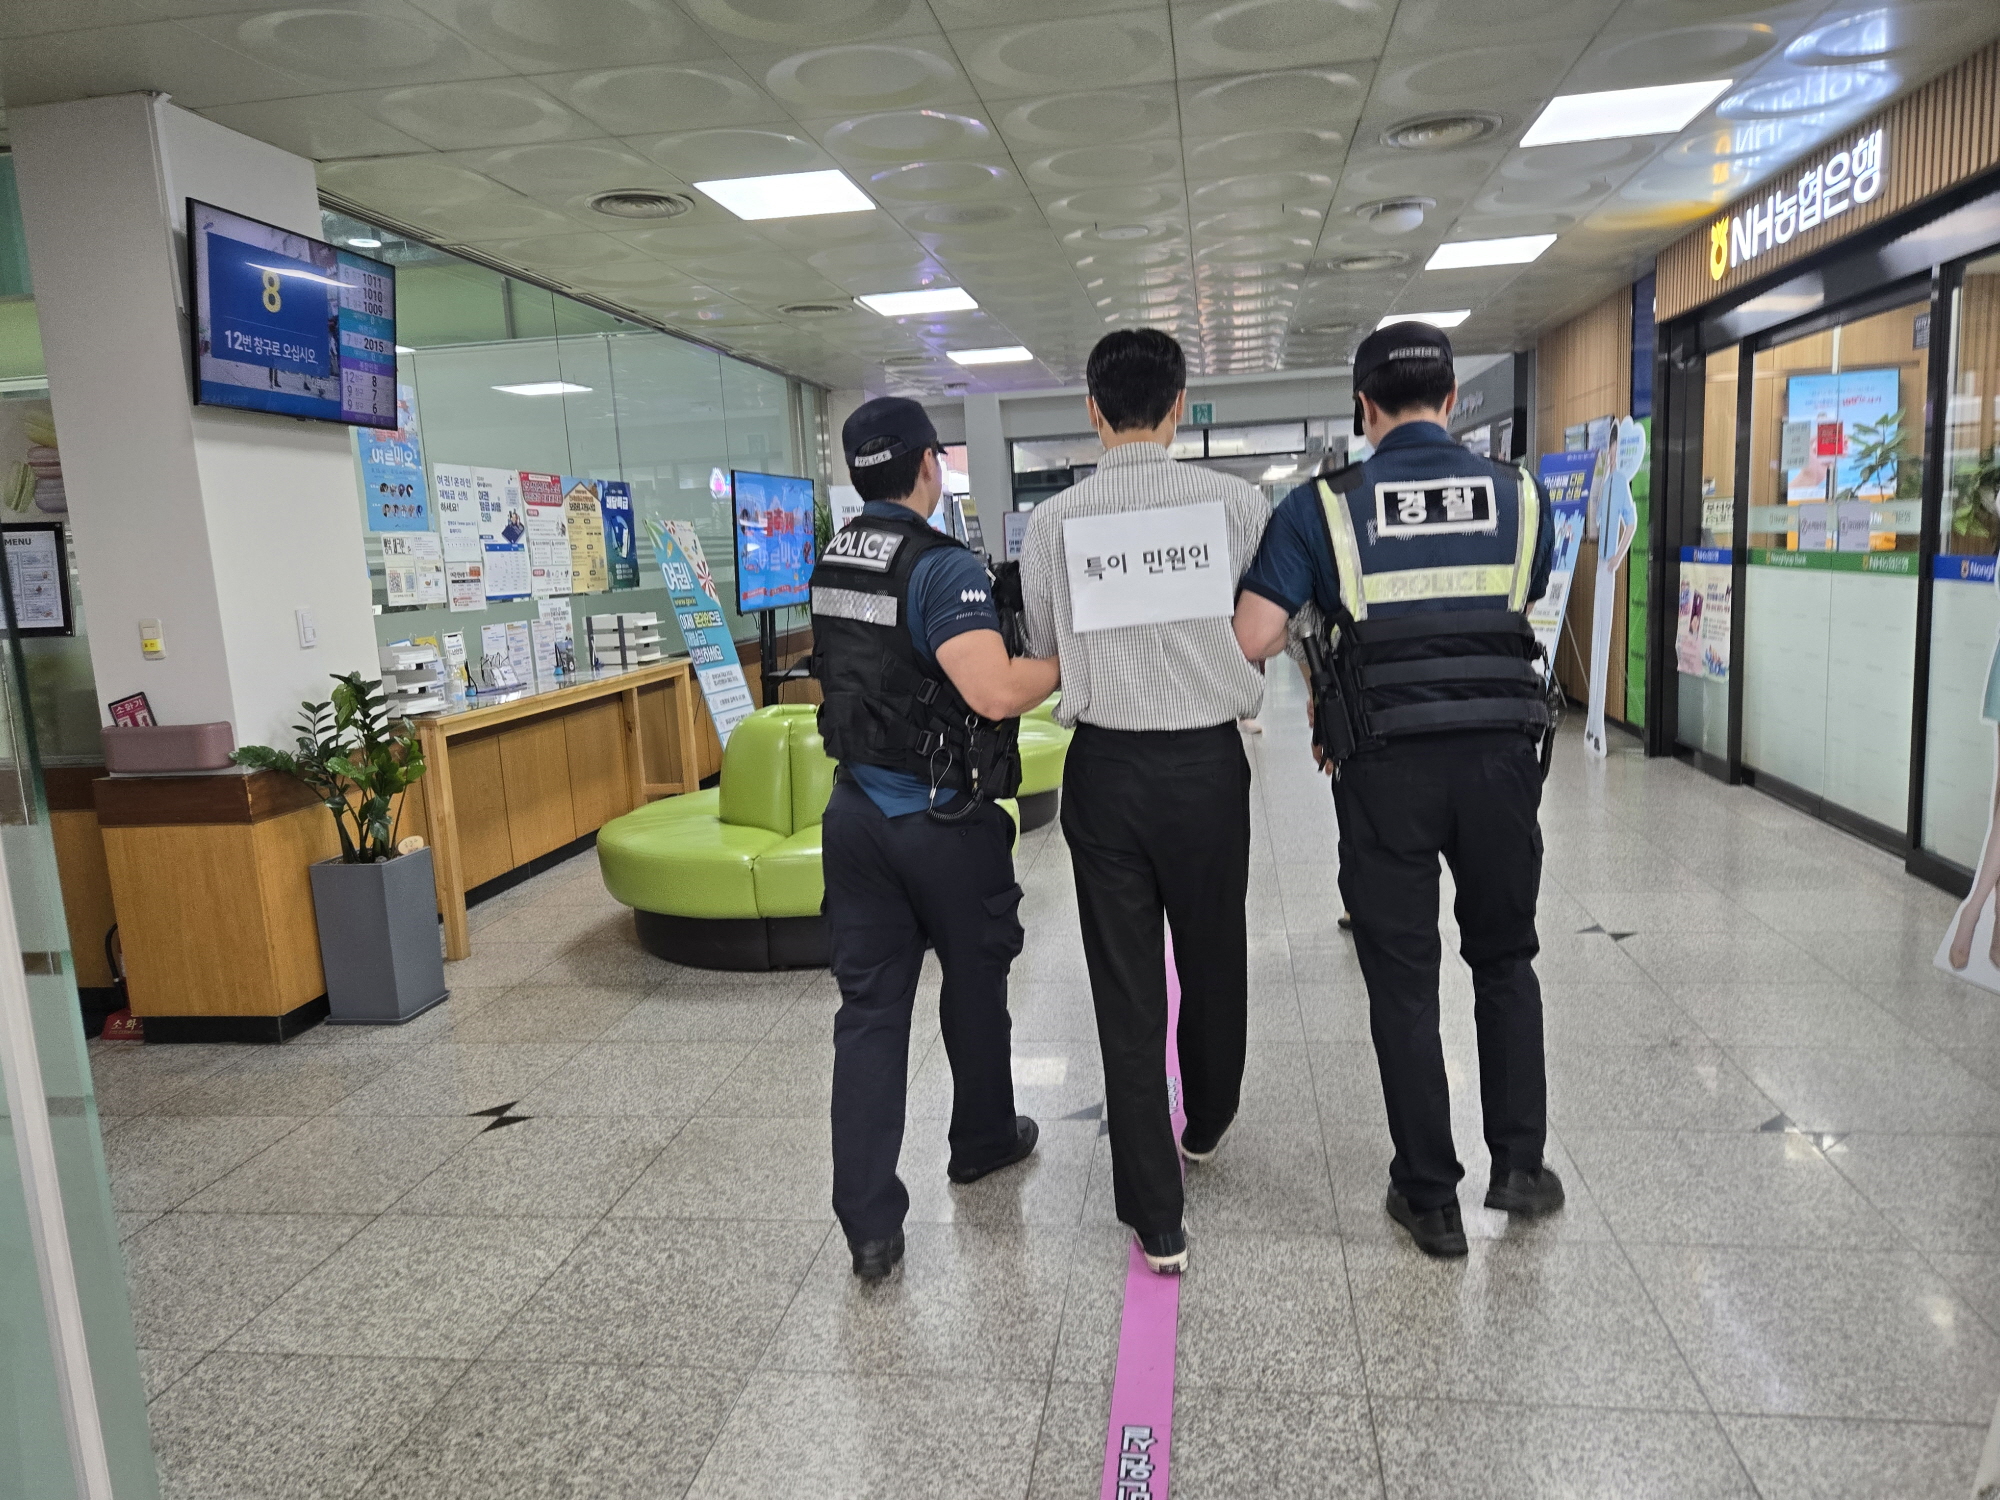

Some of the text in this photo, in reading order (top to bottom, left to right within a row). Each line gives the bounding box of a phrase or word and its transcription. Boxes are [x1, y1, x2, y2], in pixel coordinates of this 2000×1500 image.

[1731, 128, 1882, 268] NH농협은행
[363, 273, 382, 289] 1011
[262, 271, 281, 313] 8
[363, 288, 383, 302] 1010
[363, 302, 383, 316] 1009
[225, 330, 319, 364] 12번 창구로 오십시오
[364, 338, 384, 353] 2015
[345, 371, 355, 383] 12
[372, 376, 377, 387] 8
[372, 389, 377, 401] 7
[372, 403, 378, 414] 6
[858, 453, 887, 467] POLICE
[439, 490, 456, 500] 재발급
[440, 502, 459, 512] 하세요!
[5, 537, 32, 546] MENU
[825, 531, 904, 561] POLICE
[1084, 543, 1210, 581] 특이 민원인
[662, 562, 694, 591] 여권!
[1390, 568, 1488, 599] POLICE
[116, 699, 143, 714] 소화기
[111, 1018, 143, 1030] 소화
